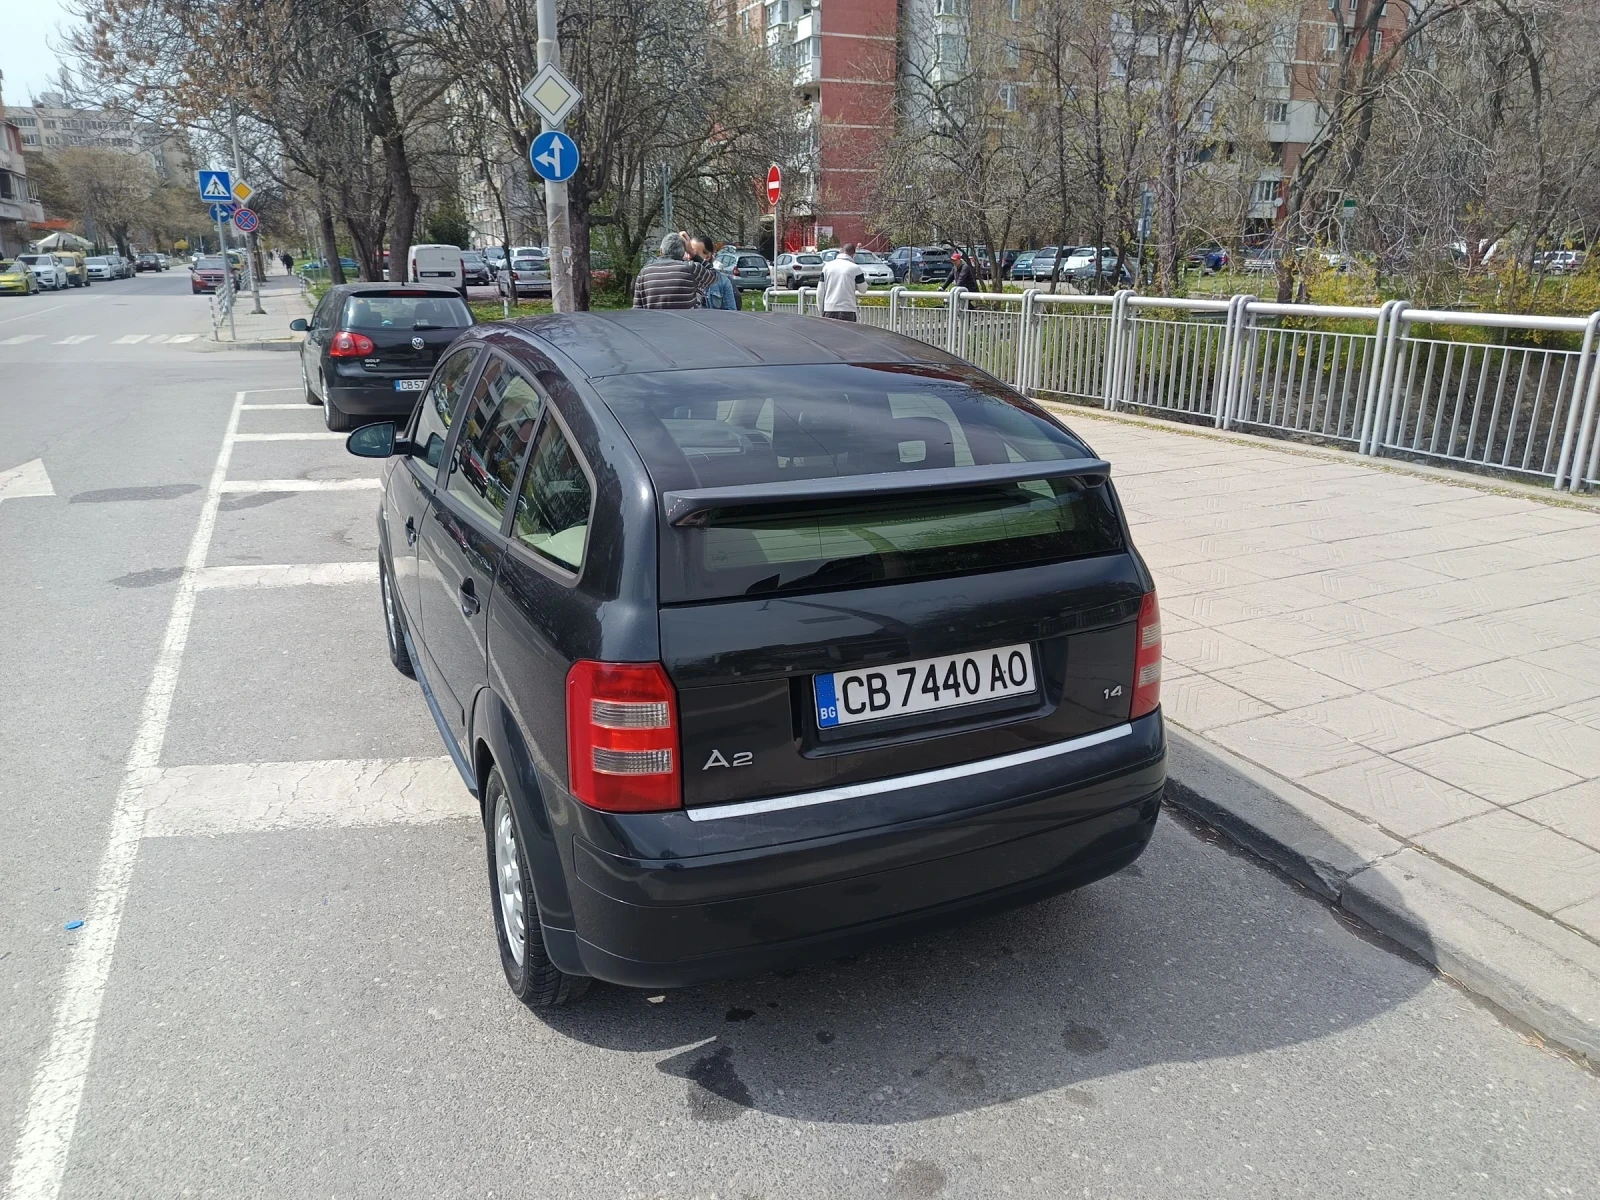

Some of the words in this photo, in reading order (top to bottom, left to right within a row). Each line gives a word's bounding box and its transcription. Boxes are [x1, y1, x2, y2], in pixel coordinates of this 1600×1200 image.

[401, 380, 413, 390] CB
[414, 380, 426, 389] 57
[842, 672, 891, 715] CB
[896, 658, 981, 707] 7440
[990, 650, 1028, 692] AO
[820, 706, 837, 720] BG
[701, 749, 753, 770] A2
